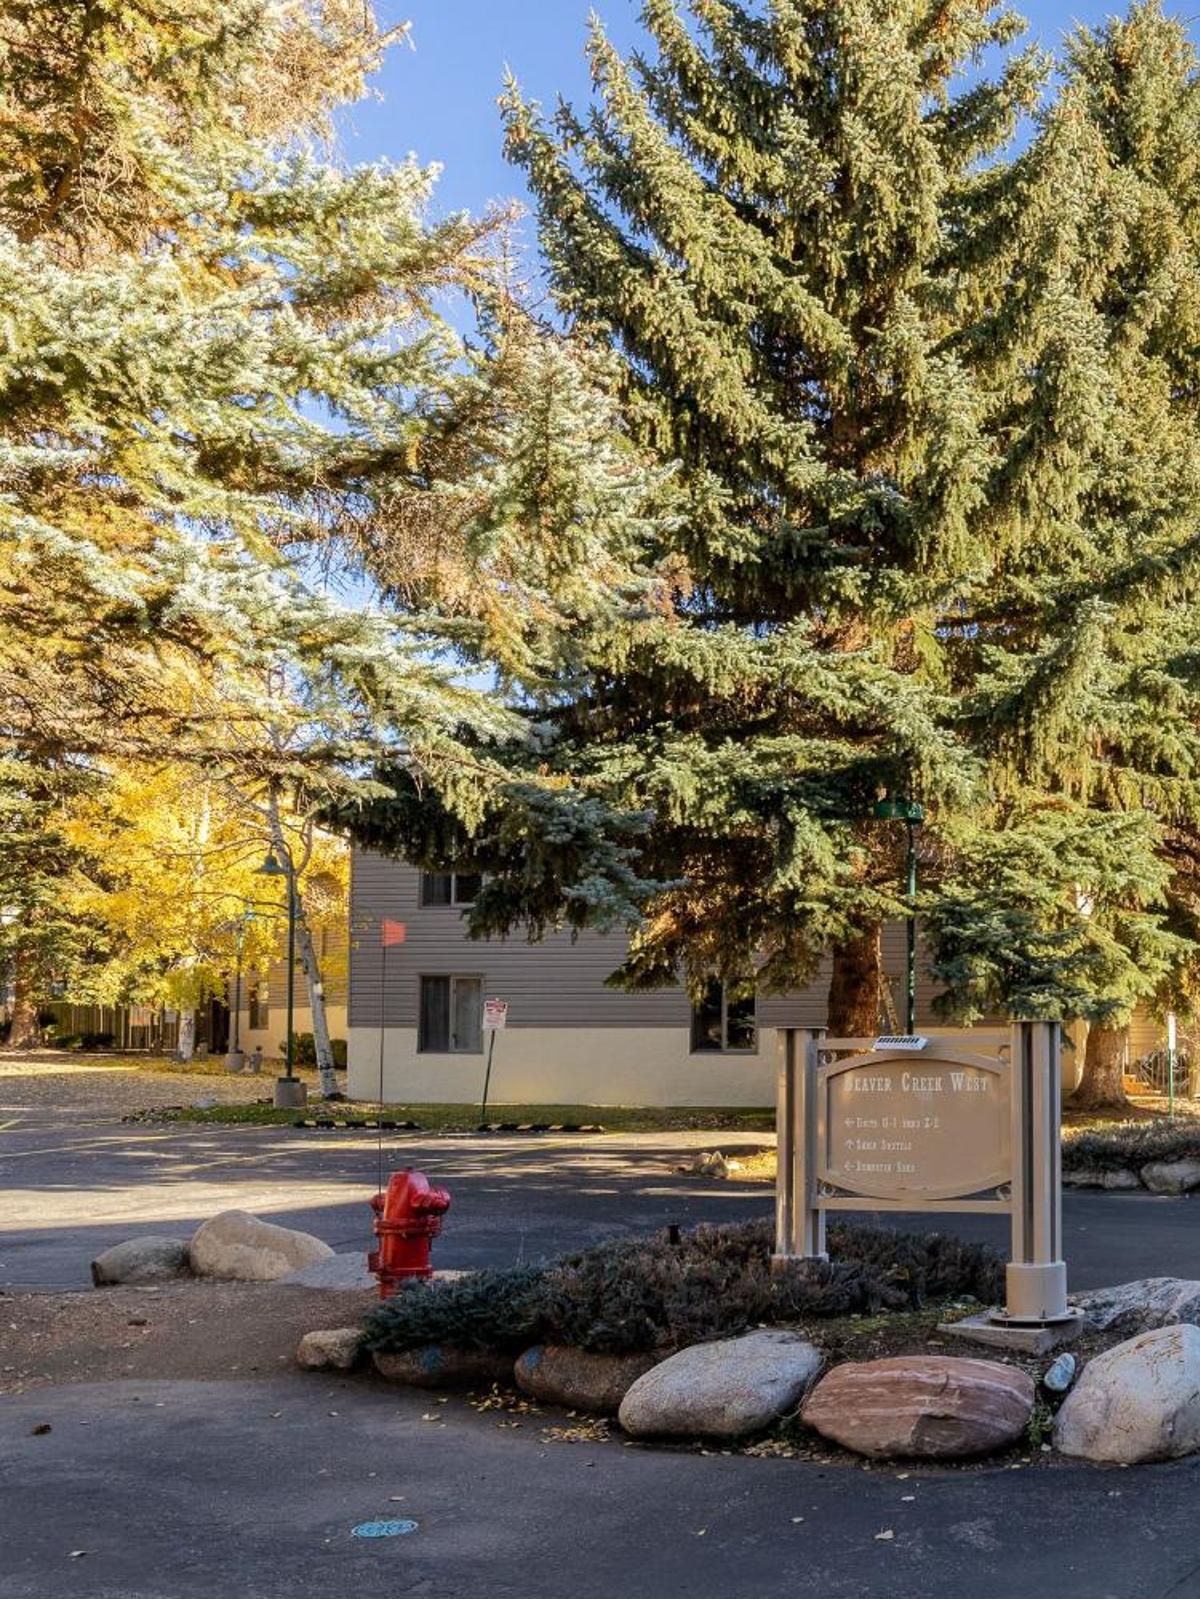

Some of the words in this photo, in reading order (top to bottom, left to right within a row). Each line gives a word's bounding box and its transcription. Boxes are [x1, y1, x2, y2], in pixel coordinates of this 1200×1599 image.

[843, 1072, 892, 1092] BEAVER
[901, 1072, 943, 1092] CREEK
[949, 1072, 988, 1092] WEST
